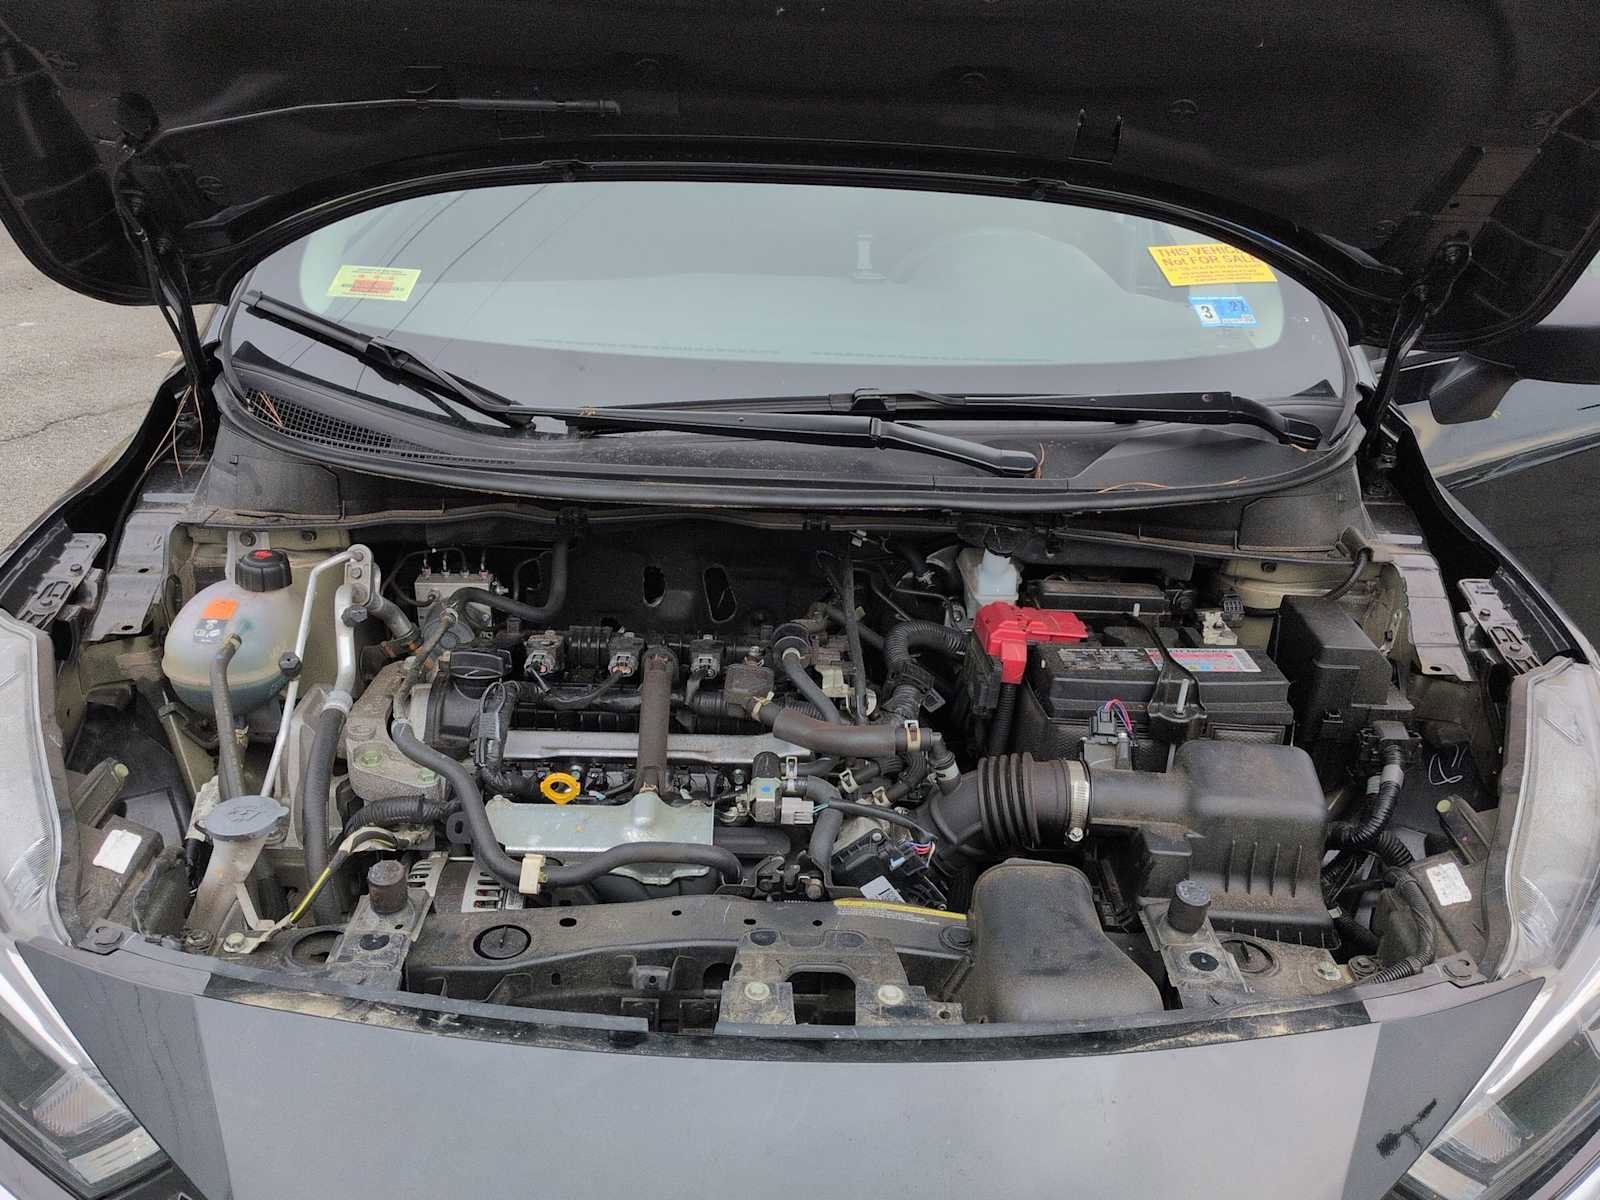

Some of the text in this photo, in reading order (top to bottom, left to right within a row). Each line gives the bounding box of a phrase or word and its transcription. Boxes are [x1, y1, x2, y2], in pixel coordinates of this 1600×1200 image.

[1158, 245, 1241, 257] THIS VEHIC
[1190, 255, 1218, 265] FOR
[1200, 305, 1214, 320] 3
